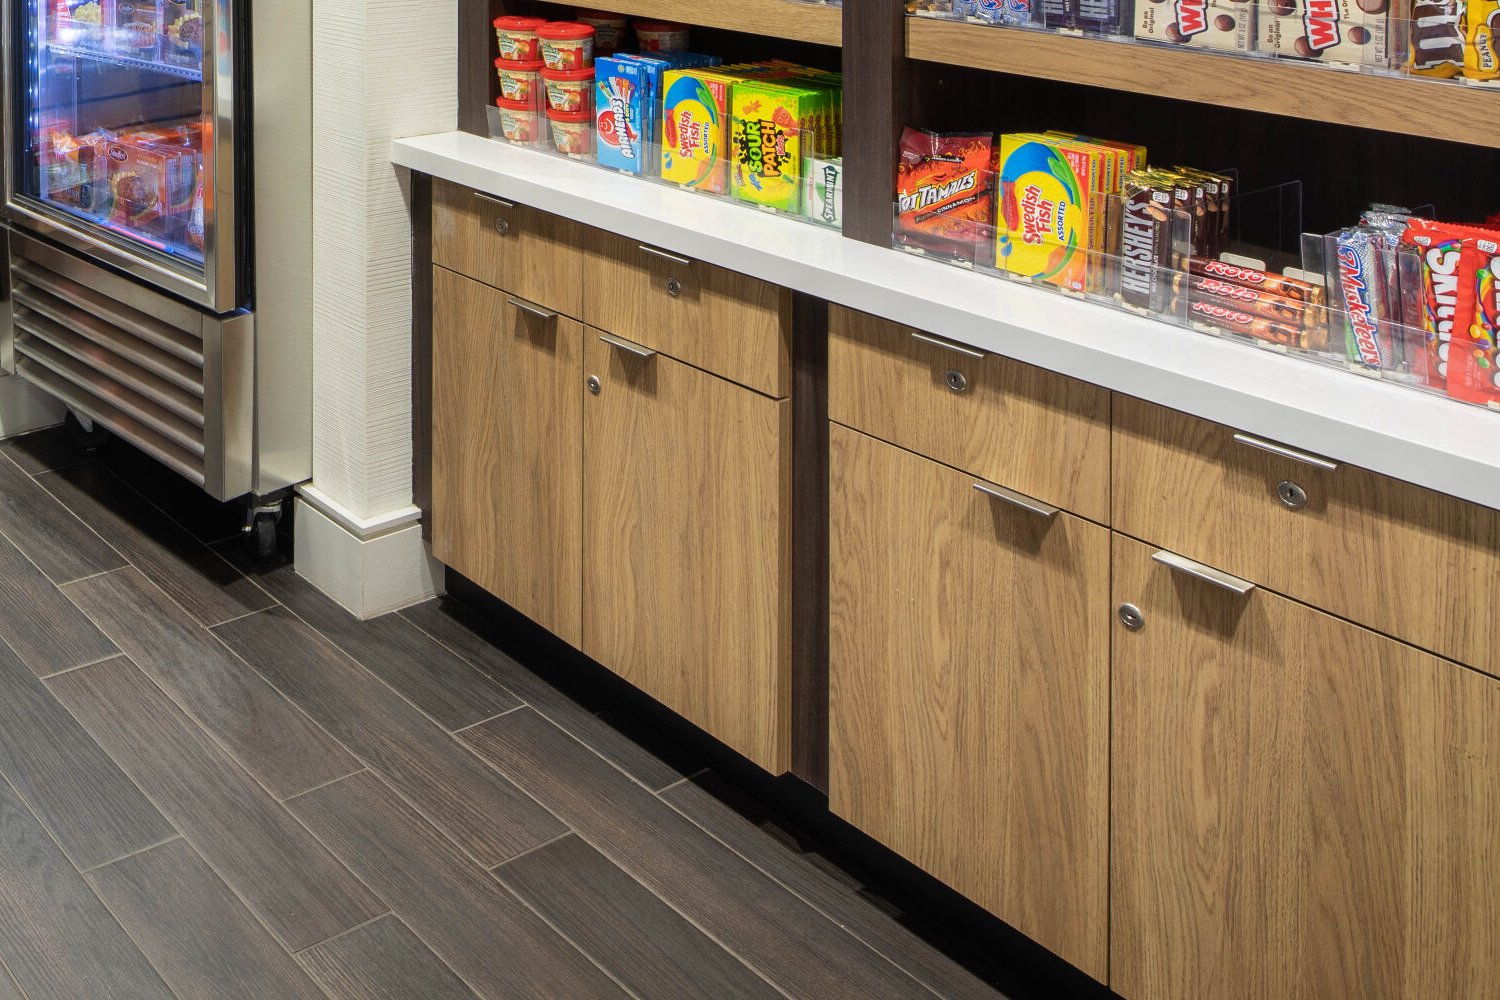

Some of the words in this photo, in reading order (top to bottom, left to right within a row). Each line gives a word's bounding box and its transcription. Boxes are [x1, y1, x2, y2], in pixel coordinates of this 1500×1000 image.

[1268, 24, 1274, 33] an
[1268, 35, 1274, 43] Be
[1273, 20, 1281, 48] Original
[1483, 33, 1492, 69] PEANUT
[612, 98, 635, 159] AIRHEADS
[679, 111, 693, 158] Swedish
[689, 122, 700, 149] Fish
[746, 122, 763, 173] SOUR
[776, 135, 785, 156] Kids
[760, 120, 781, 177] PATCH
[824, 167, 836, 220] SPEARMINT
[919, 171, 975, 209] TAMALES
[937, 196, 975, 213] CINNAMON
[1020, 185, 1042, 244] Swedish
[1036, 200, 1053, 232] Fish
[1057, 201, 1066, 241] ASSORTED
[1124, 200, 1153, 294] HERSHEY'S
[1340, 262, 1381, 368] Musketeers
